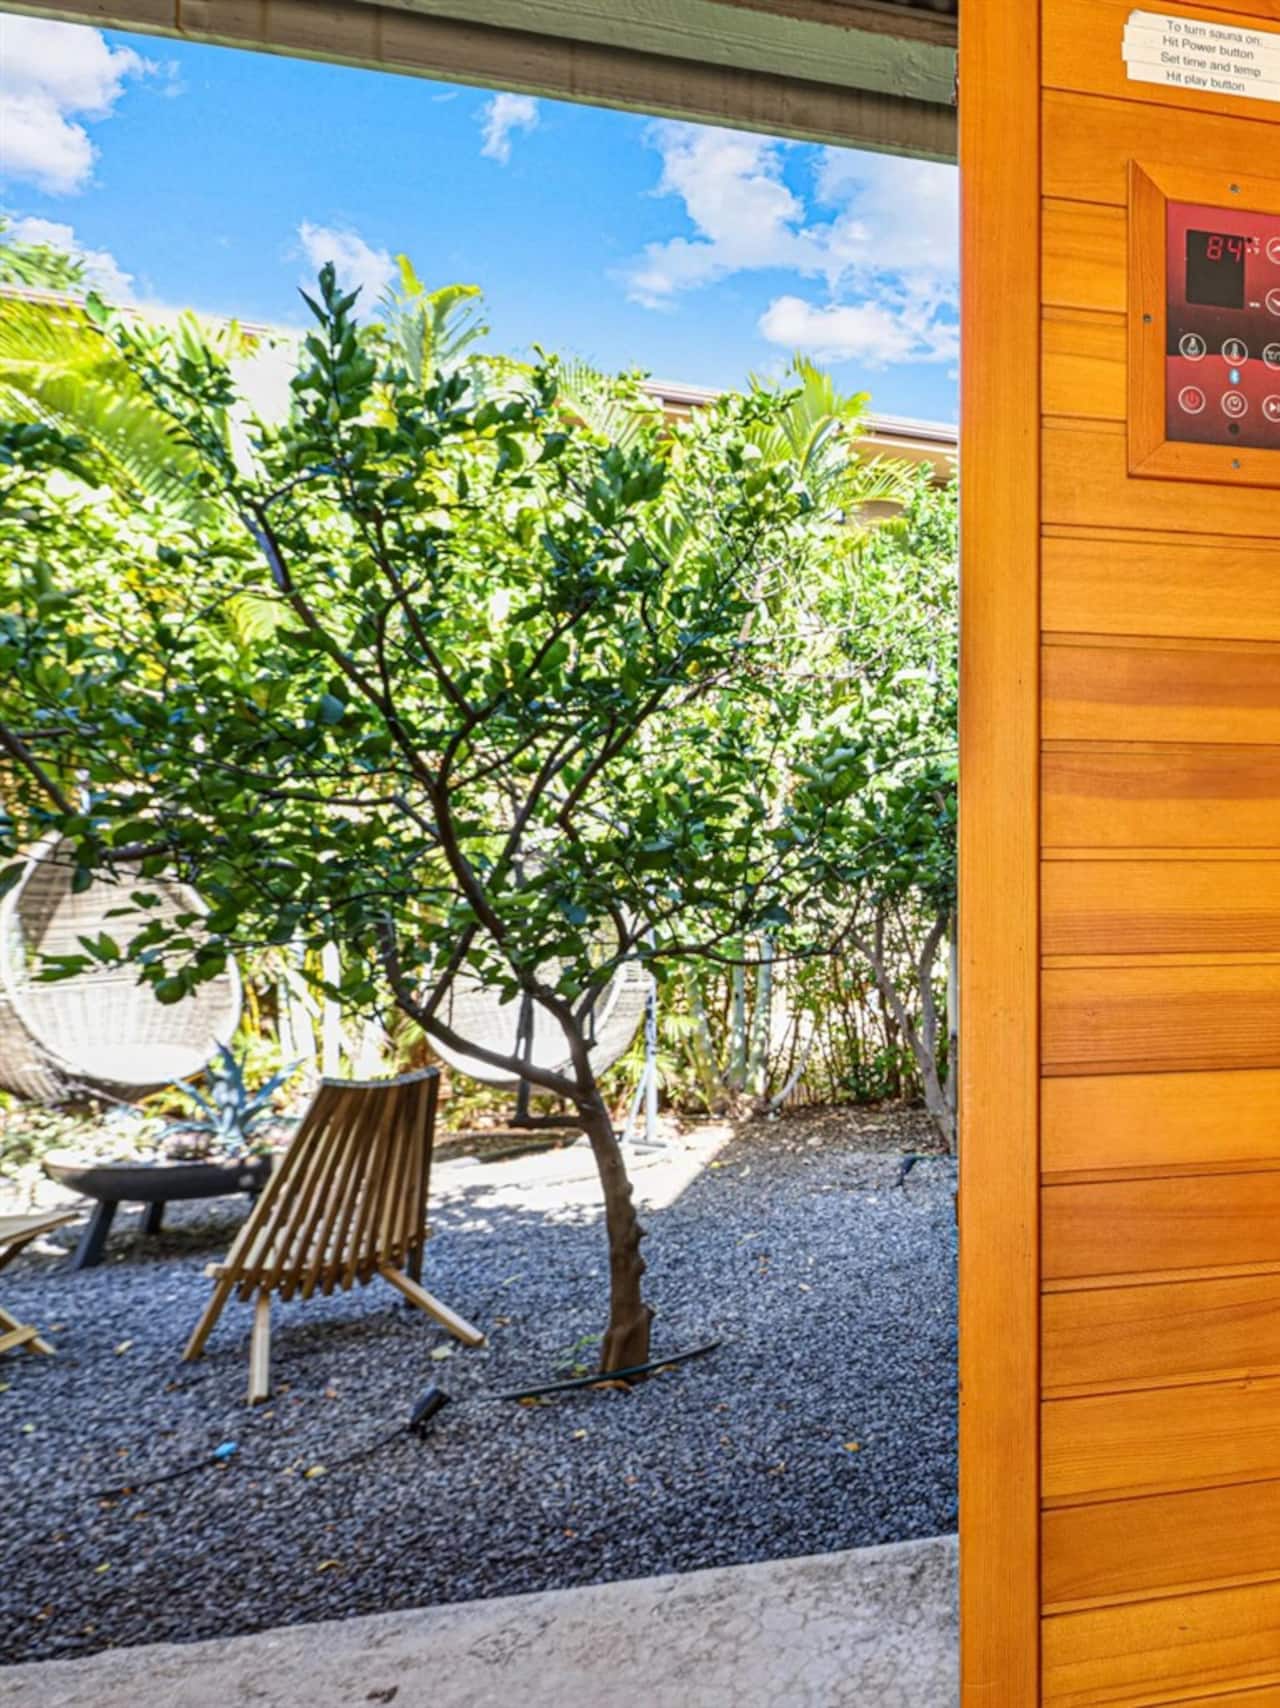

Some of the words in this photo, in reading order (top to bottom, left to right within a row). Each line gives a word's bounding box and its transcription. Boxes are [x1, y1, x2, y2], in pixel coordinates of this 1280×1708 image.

[1167, 20, 1182, 32] To
[1184, 24, 1206, 36] turn
[1209, 29, 1243, 43] sauna
[1162, 35, 1179, 48] Hit
[1182, 39, 1217, 53] Power
[1219, 45, 1254, 59] button
[1160, 51, 1180, 64] Set
[1183, 56, 1207, 69] time
[1209, 61, 1231, 72] and
[1234, 64, 1261, 78] temp
[1166, 71, 1182, 83] Hit
[1184, 74, 1208, 88] play
[1211, 78, 1245, 91] button
[1207, 236, 1242, 263] 84
